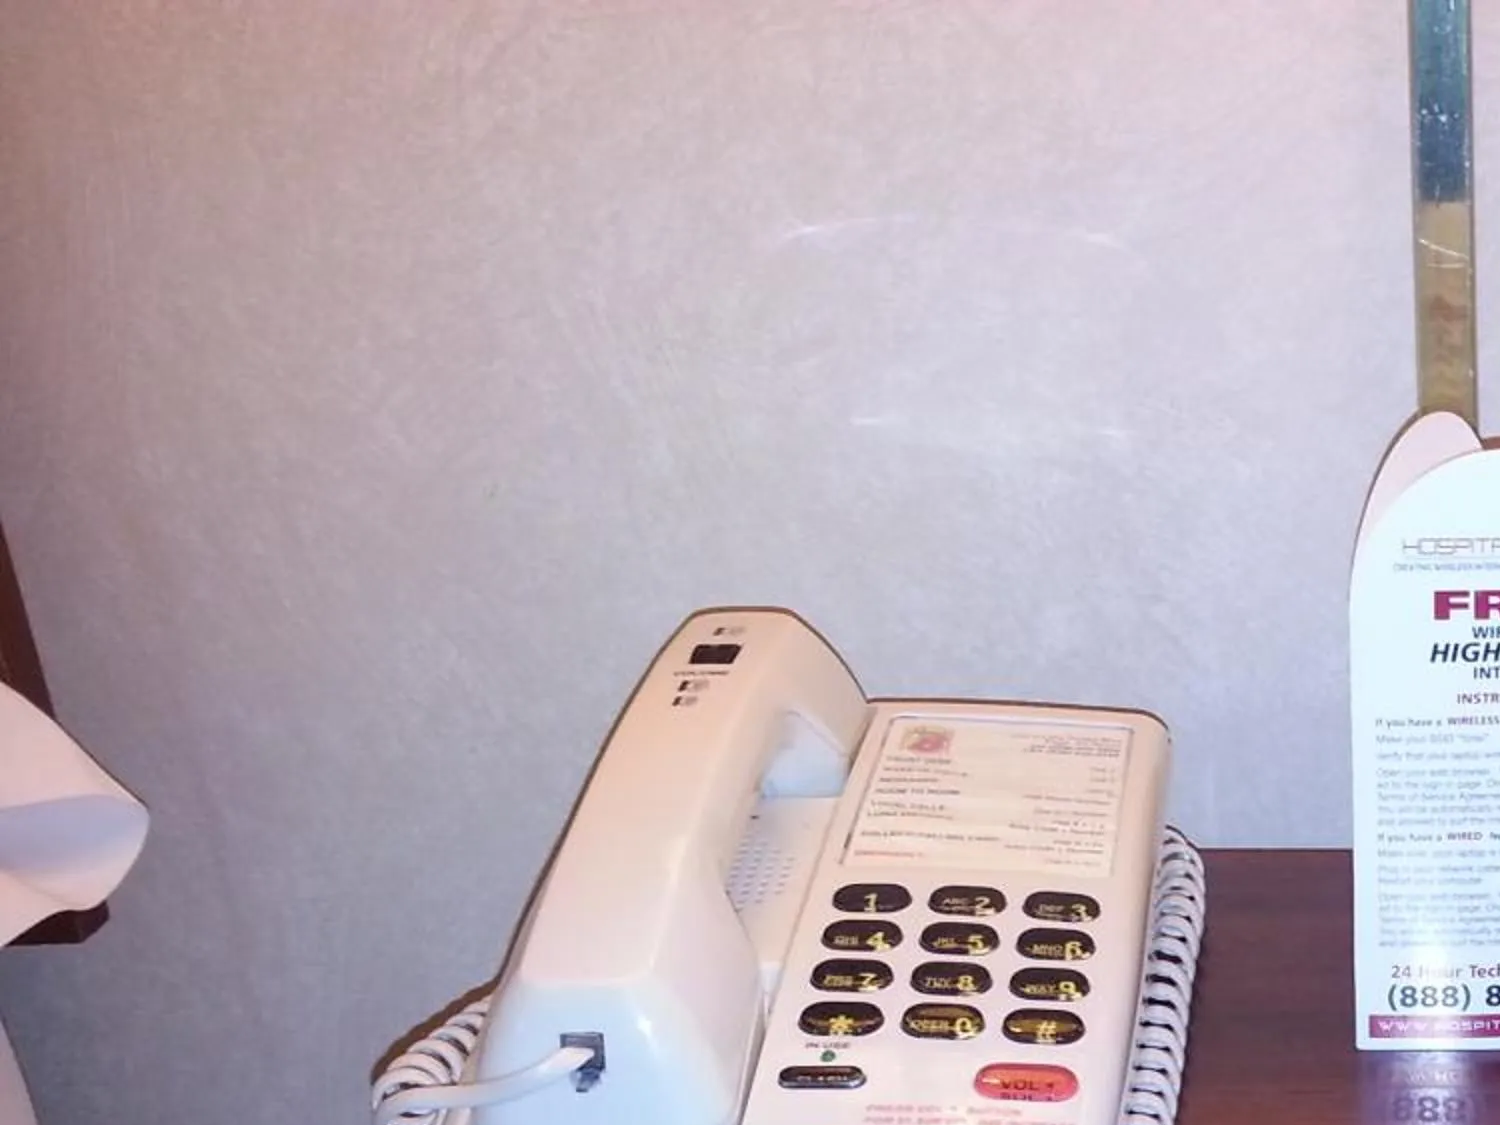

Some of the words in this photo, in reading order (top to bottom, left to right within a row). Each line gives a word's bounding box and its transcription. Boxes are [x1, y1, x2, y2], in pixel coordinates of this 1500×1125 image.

[1386, 719, 1406, 730] you
[1408, 716, 1433, 727] have
[1447, 715, 1500, 726] WIRELESS
[1387, 832, 1407, 844] you
[1409, 831, 1433, 842] have
[1447, 830, 1484, 842] WIRED
[863, 892, 878, 912] 1
[975, 895, 993, 914] 2
[1070, 903, 1091, 921] 3
[865, 931, 890, 950] 4
[968, 934, 990, 954] 5
[1064, 941, 1089, 960] 6
[1391, 964, 1412, 979] 24
[1419, 963, 1464, 979] Hur
[857, 973, 880, 991] 7
[957, 975, 977, 992] 8
[1058, 981, 1083, 1001] 9
[1387, 983, 1472, 1012] (888)
[1000, 1079, 1040, 1091] VOL
